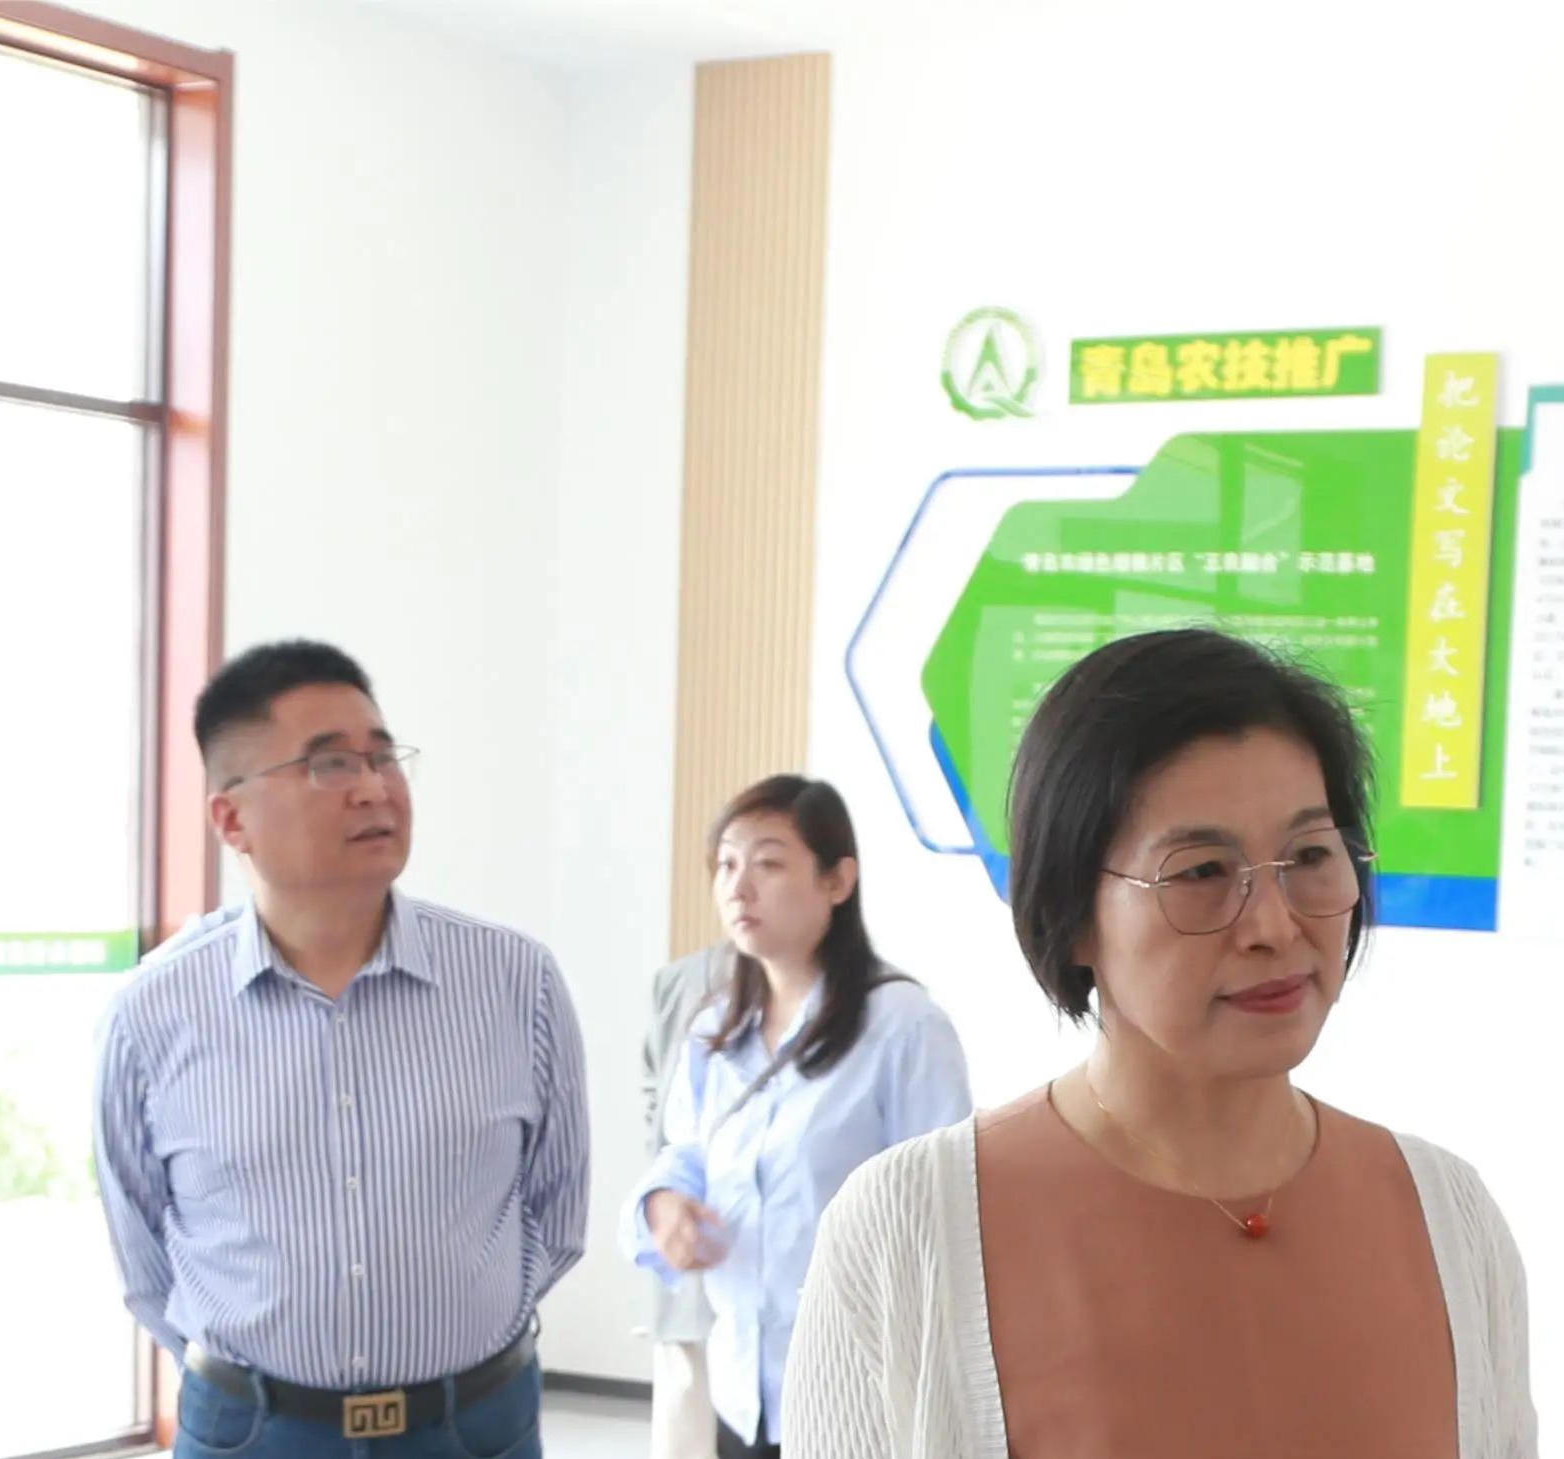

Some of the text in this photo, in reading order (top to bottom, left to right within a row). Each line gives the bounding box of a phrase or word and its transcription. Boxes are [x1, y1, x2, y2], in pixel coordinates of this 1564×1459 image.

[1077, 334, 1373, 397] 青岛农技推广
[1419, 370, 1481, 781] 把论文写在大地上
